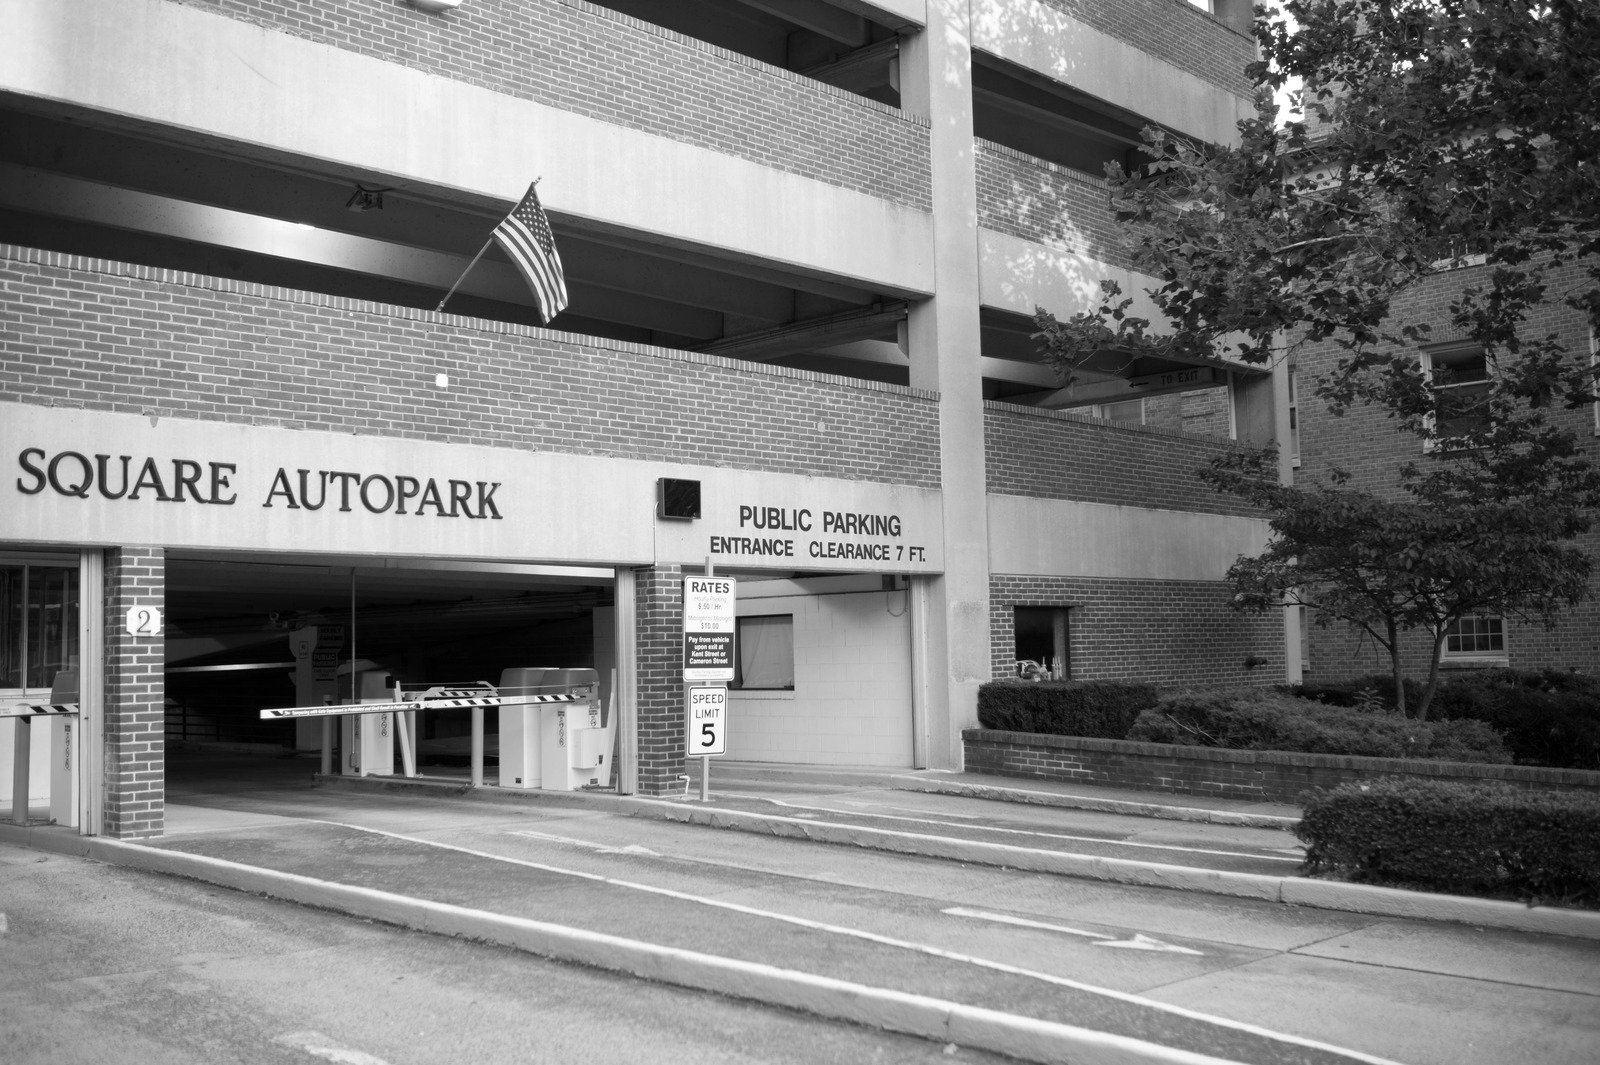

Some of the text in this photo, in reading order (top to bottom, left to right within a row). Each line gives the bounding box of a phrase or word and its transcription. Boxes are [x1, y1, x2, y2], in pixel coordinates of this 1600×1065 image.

[1160, 370, 1198, 384] TO EXIT
[17, 447, 502, 520] SQUARE AUTOPARK
[740, 505, 901, 536] PUBLIC PARKING
[710, 536, 926, 562] ENTRANCE CLEARANCE 7 FT.
[692, 582, 729, 594] RATES
[136, 610, 152, 633] 2
[692, 694, 724, 704] SPEED
[695, 709, 720, 719] LIMIT
[701, 723, 715, 747] 5
